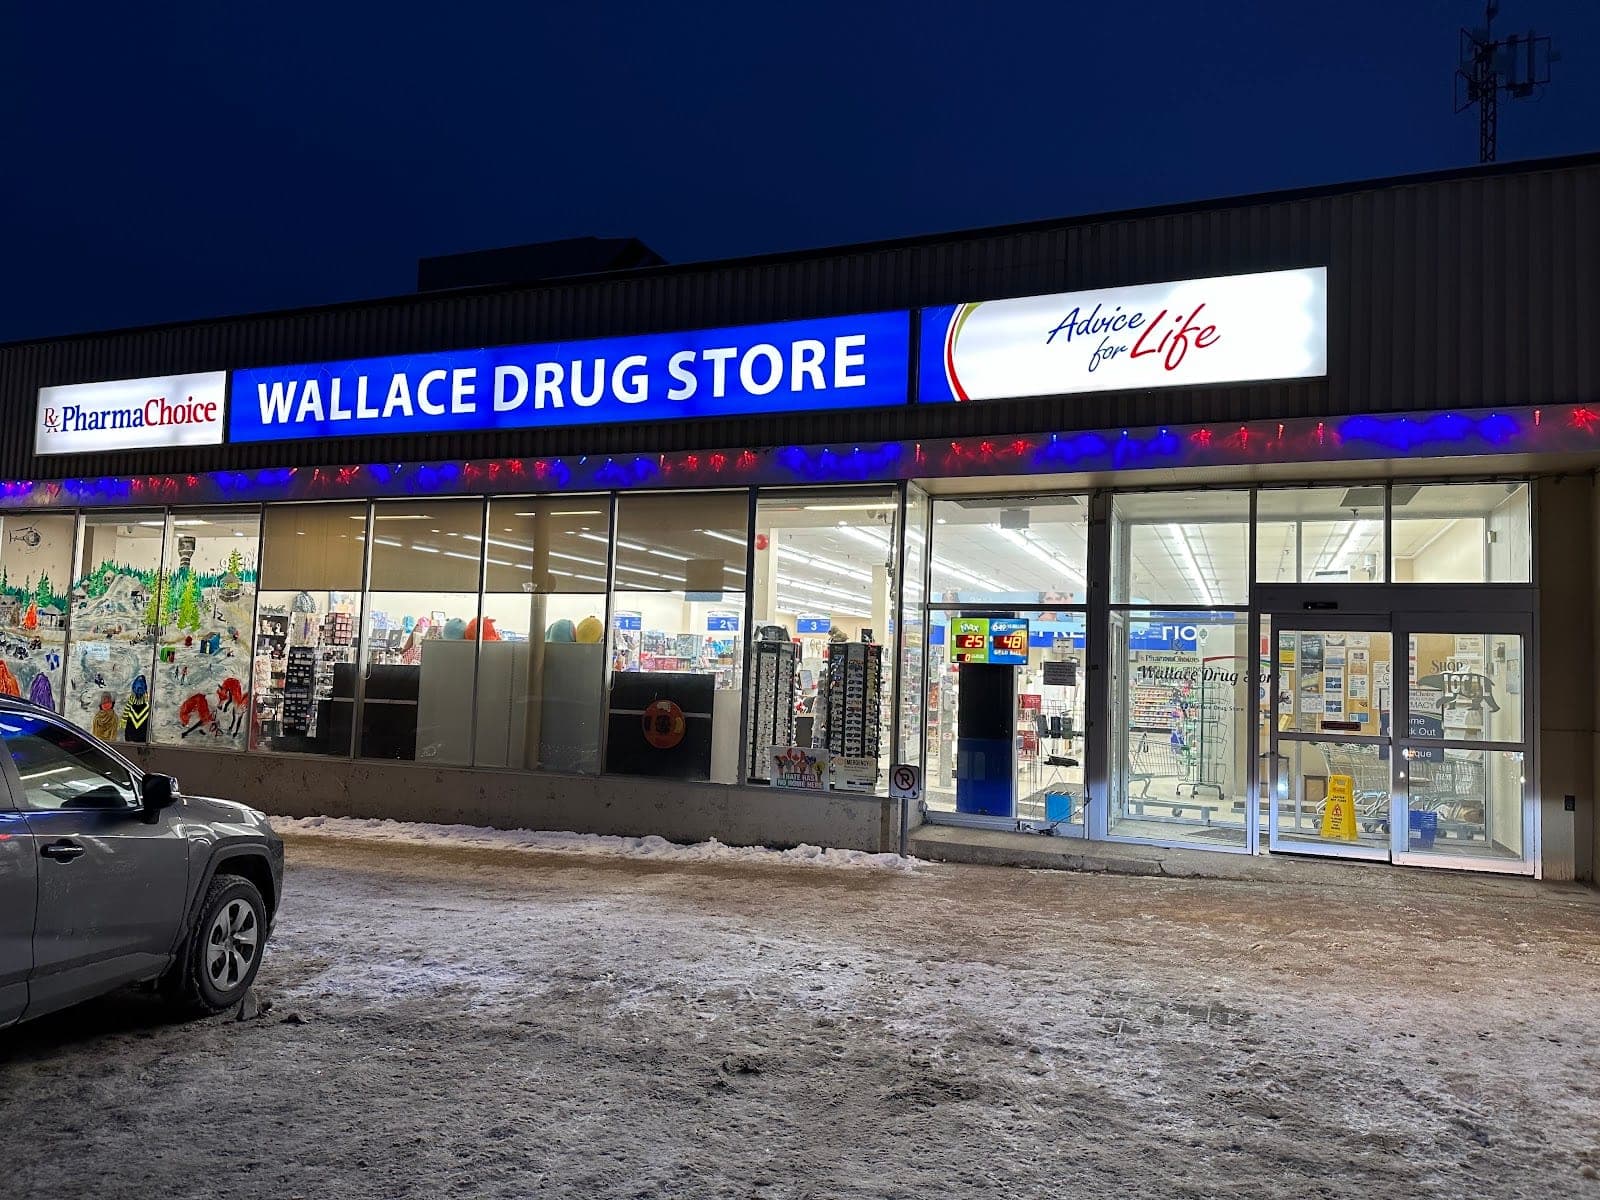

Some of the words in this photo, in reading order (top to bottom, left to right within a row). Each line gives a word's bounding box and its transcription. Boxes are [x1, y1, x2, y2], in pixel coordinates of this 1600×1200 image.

[1046, 303, 1146, 345] Advice
[1088, 336, 1128, 372] for
[1130, 303, 1220, 371] Life
[257, 367, 477, 425] WALLACE
[493, 355, 648, 412] DRUG
[667, 334, 866, 401] STORE
[60, 396, 217, 433] PharmaChoice
[720, 620, 726, 629] 2
[810, 622, 817, 631] 3
[965, 635, 983, 648] 25
[1004, 636, 1021, 649] 48
[965, 653, 971, 662] 0
[1431, 660, 1463, 673] SHOP
[1137, 665, 1198, 682] Wallace
[1202, 667, 1238, 686] Drug
[1418, 727, 1436, 736] Out
